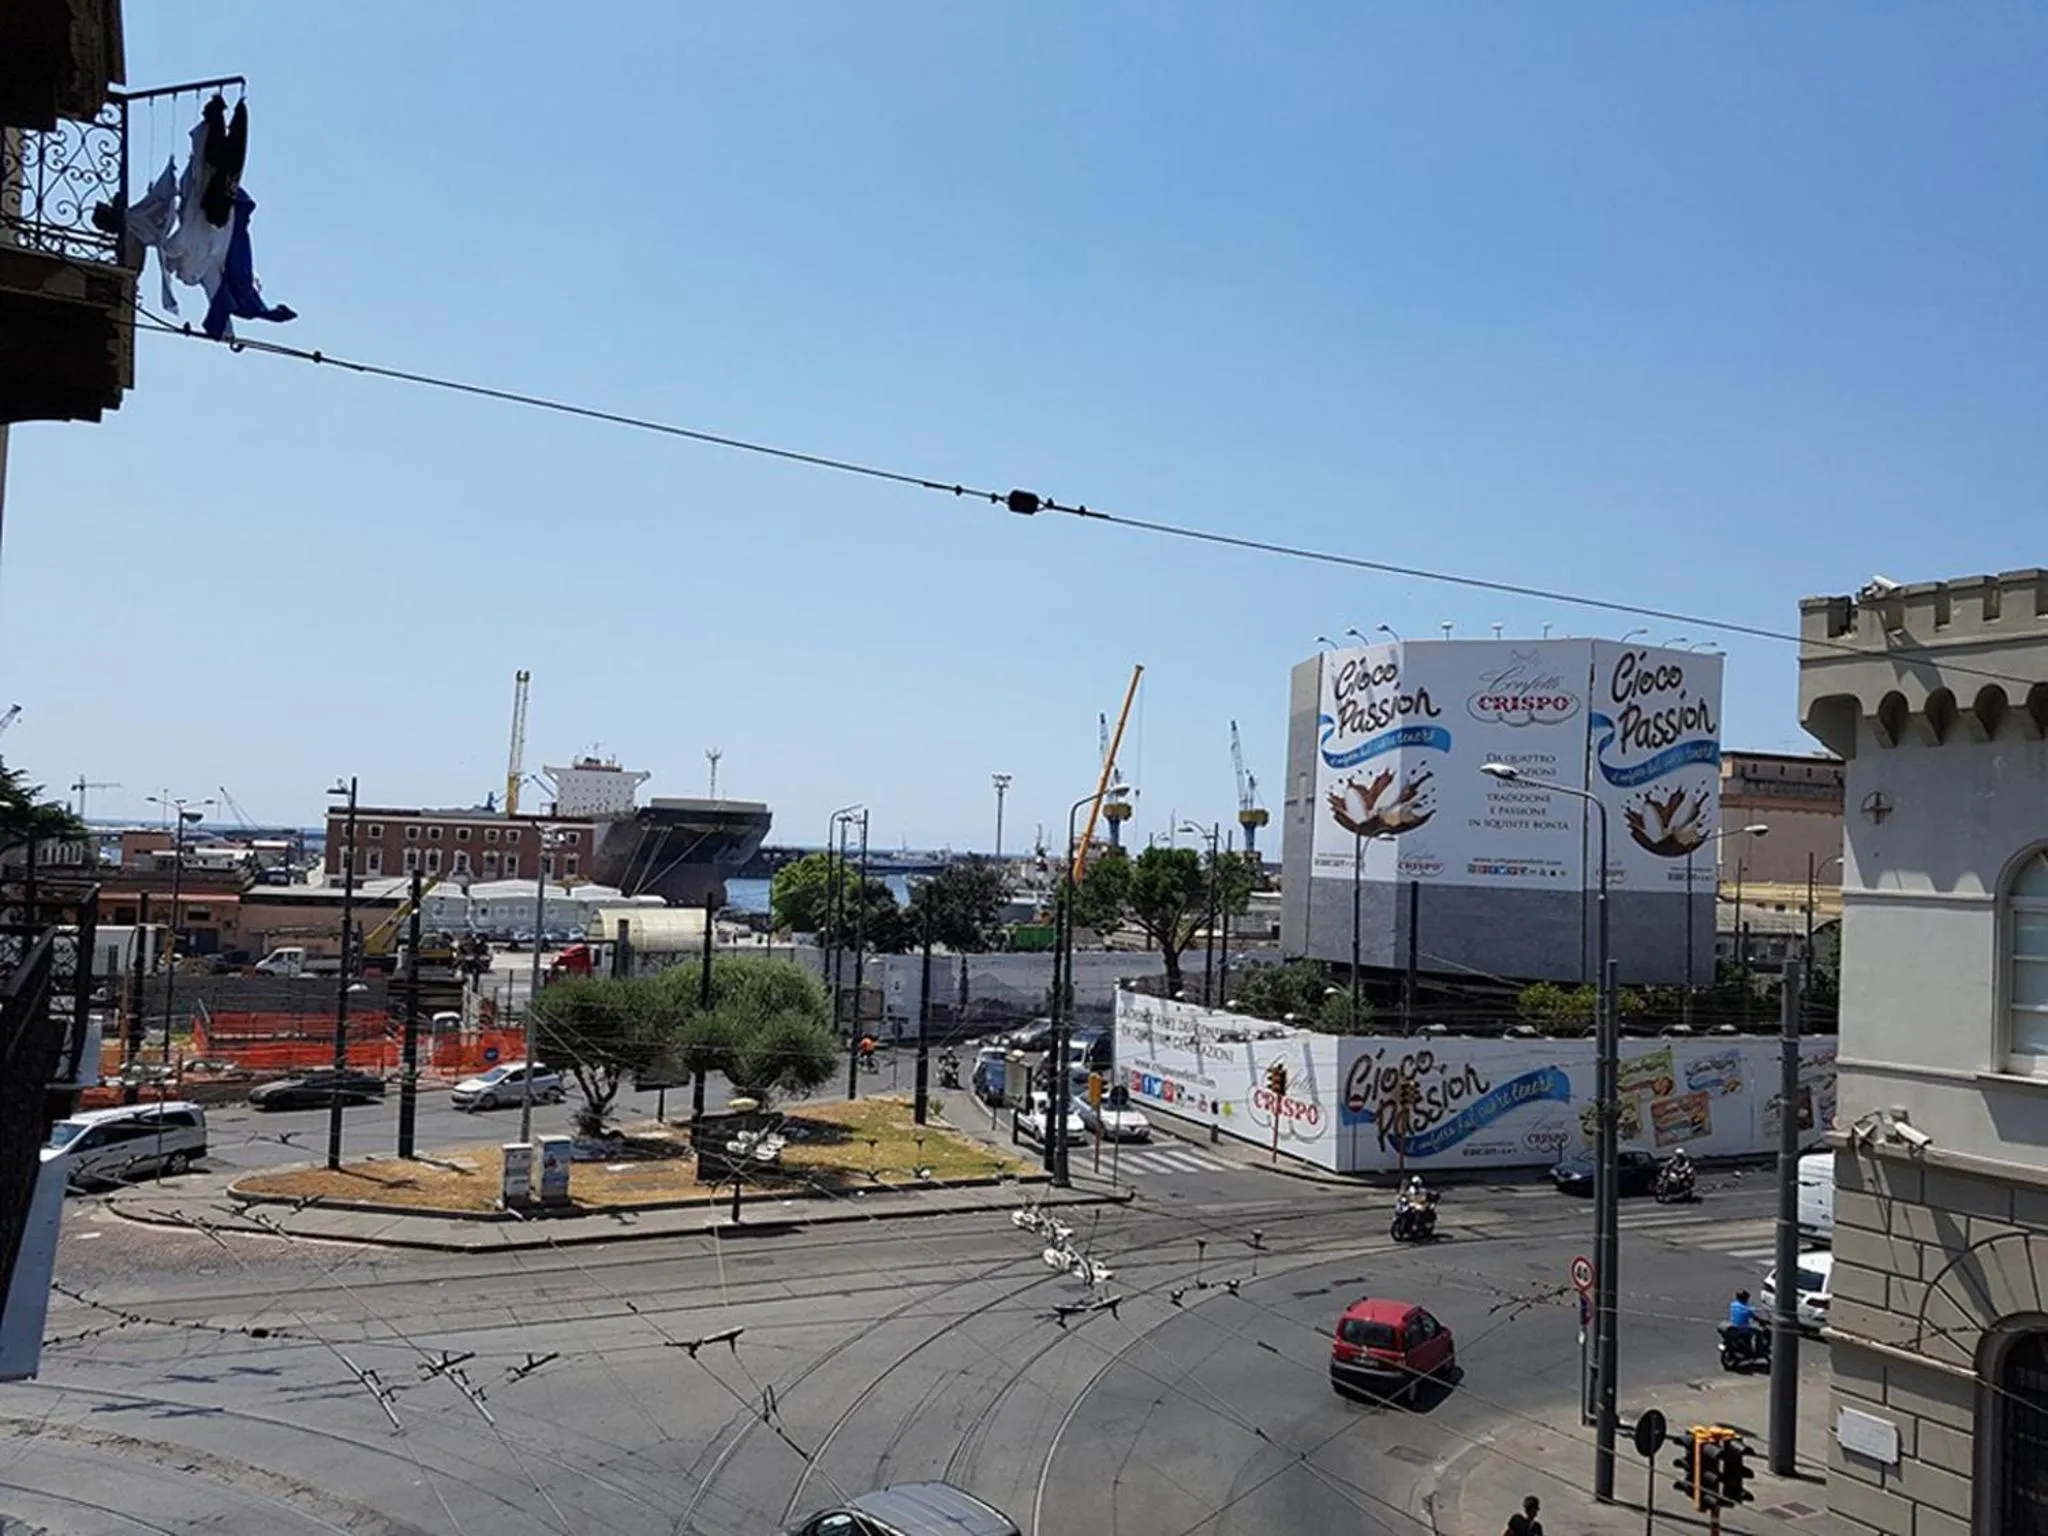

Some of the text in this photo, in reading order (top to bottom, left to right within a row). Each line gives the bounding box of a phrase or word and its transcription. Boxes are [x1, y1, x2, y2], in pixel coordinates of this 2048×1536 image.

[1335, 656, 1397, 700] Cioco
[1612, 651, 1683, 703] Cioco
[1338, 681, 1442, 738] Passion
[1477, 696, 1570, 712] CRISPO
[1618, 689, 1716, 755] Passion
[1504, 754, 1557, 763] QUATTRO
[1486, 793, 1551, 803] TRADIZIONE
[1498, 806, 1547, 816] PASSIONE
[1345, 1048, 1433, 1110] Cioco
[1576, 1265, 1589, 1282] 40
